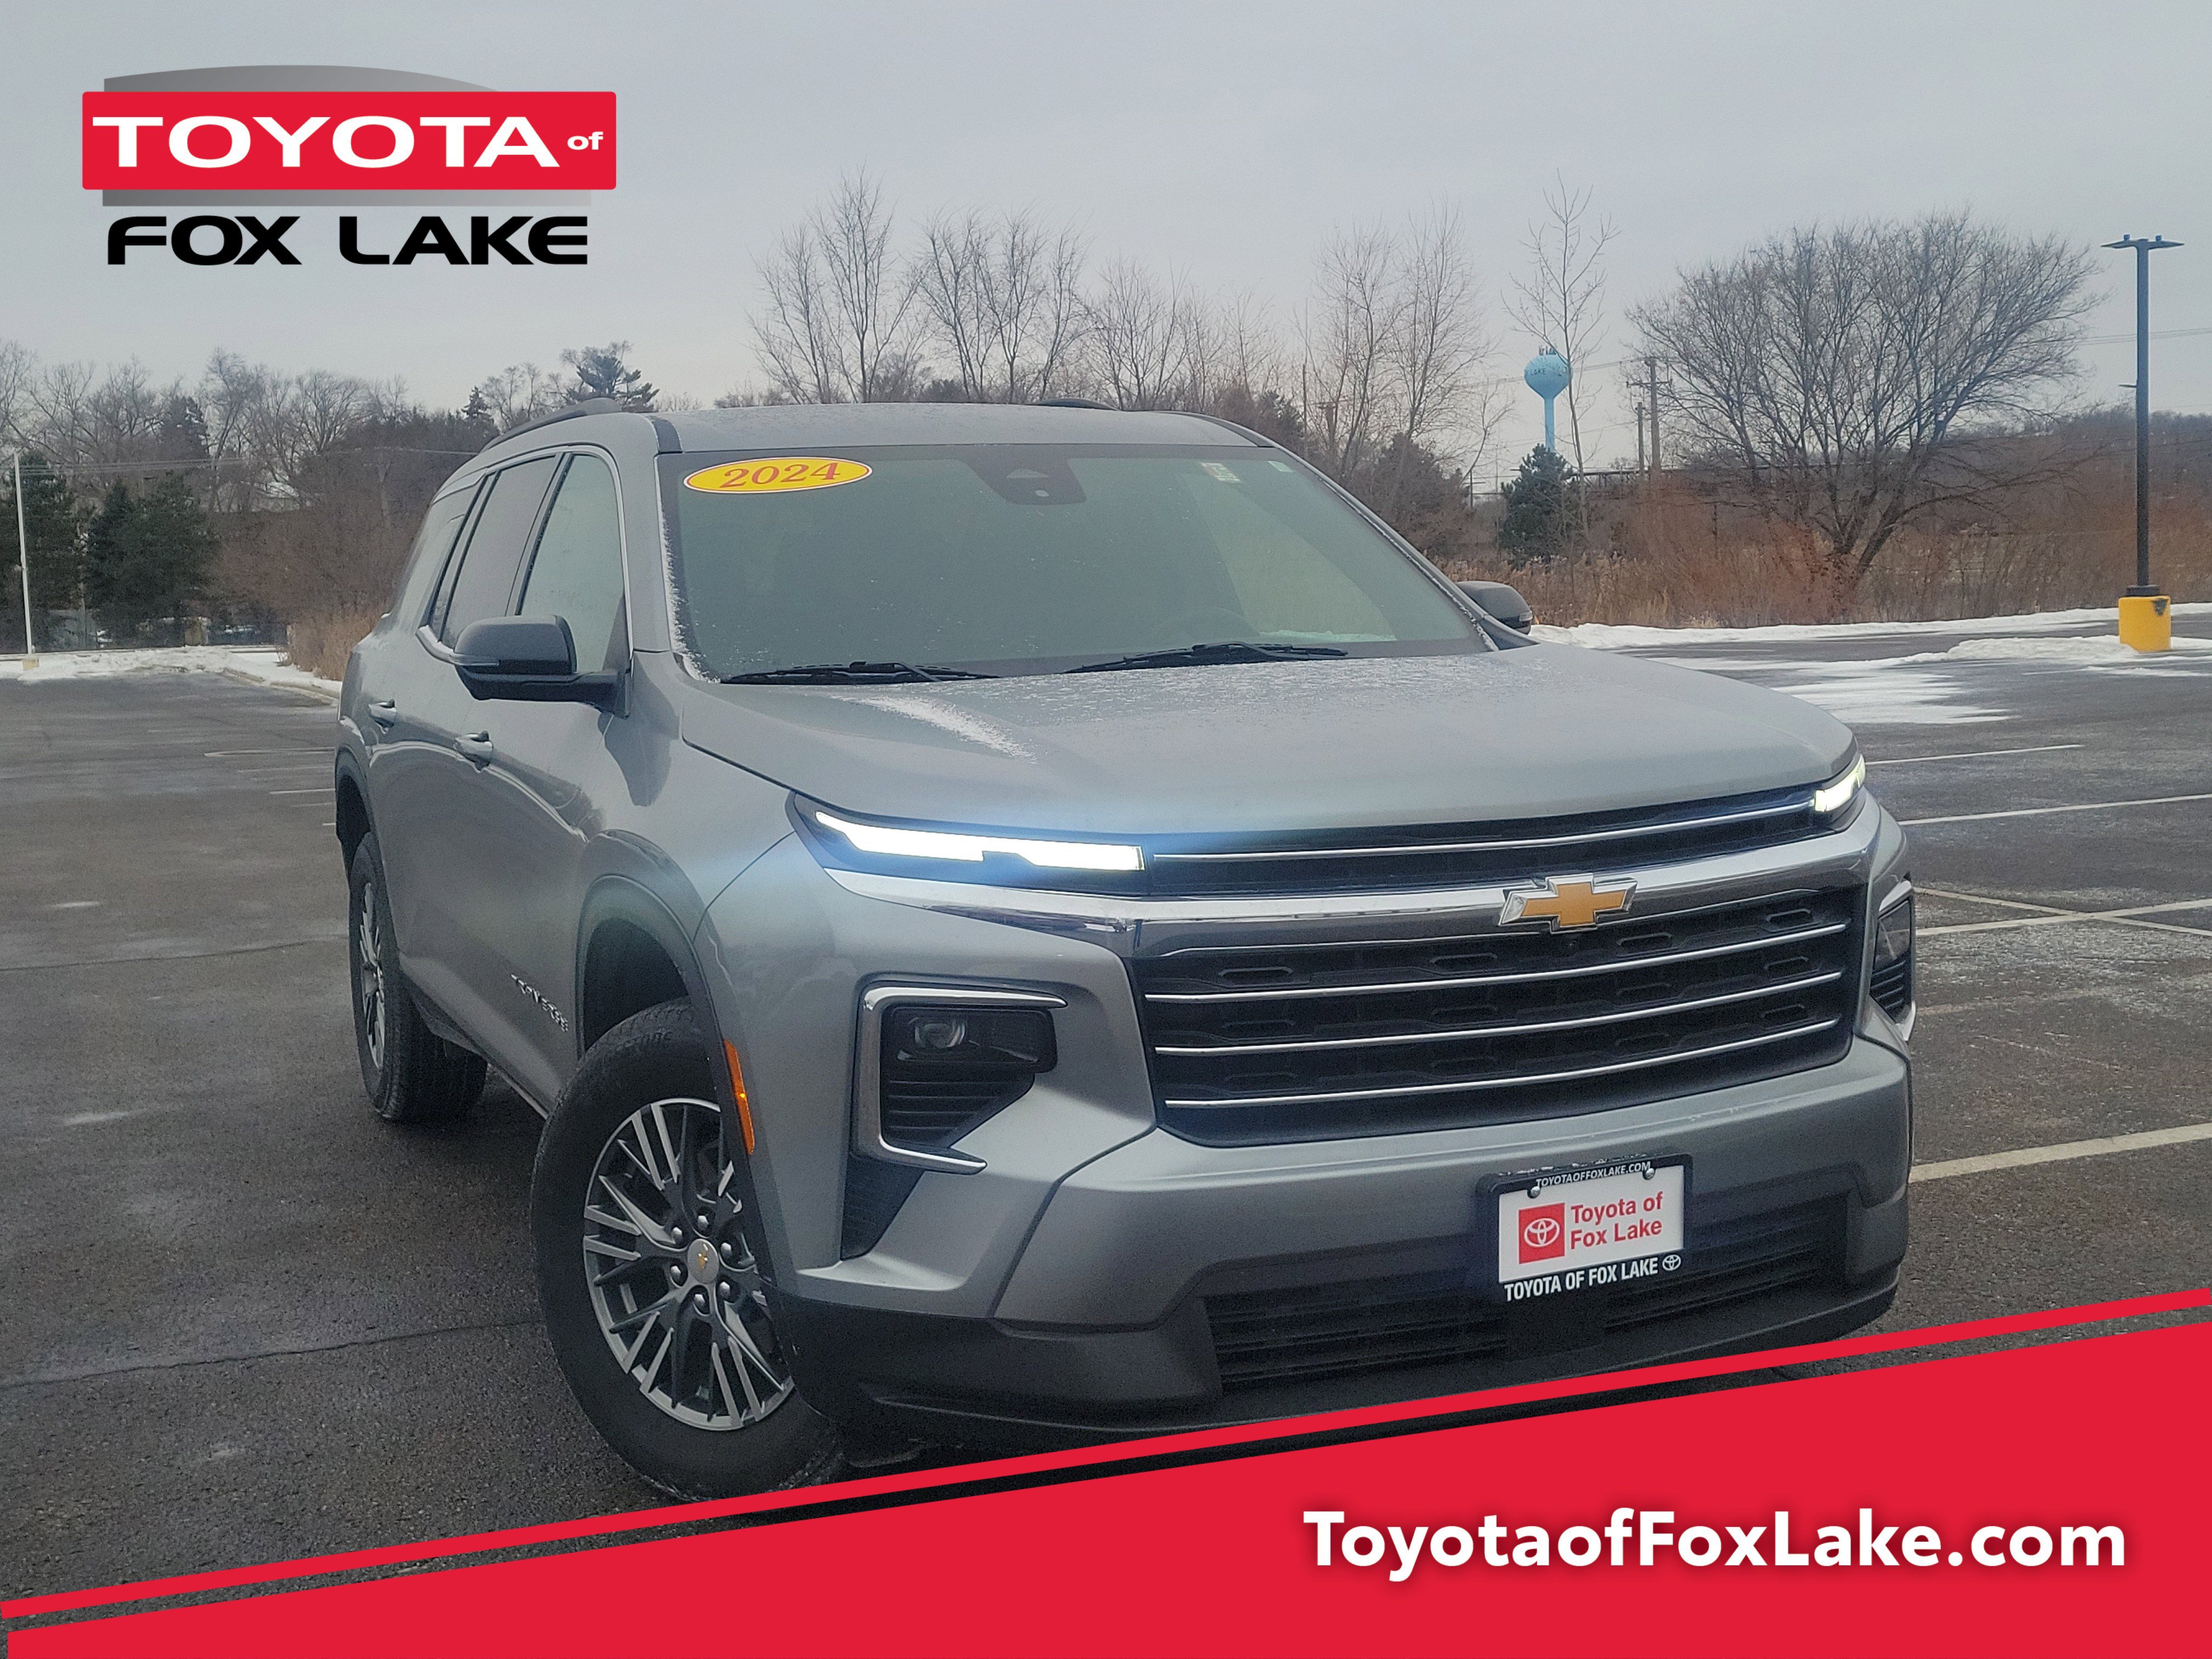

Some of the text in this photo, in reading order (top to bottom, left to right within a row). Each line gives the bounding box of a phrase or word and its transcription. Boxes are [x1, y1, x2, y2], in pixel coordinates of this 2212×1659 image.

[720, 462, 841, 488] 2024
[1536, 1161, 1651, 1187] TOYOTAOFFOXLAKE.COM
[1571, 1191, 1663, 1226] Toyota of
[1570, 1218, 1662, 1250] Fox Lake
[1504, 1257, 1658, 1301] TOYOTA OF FOX LAKE
